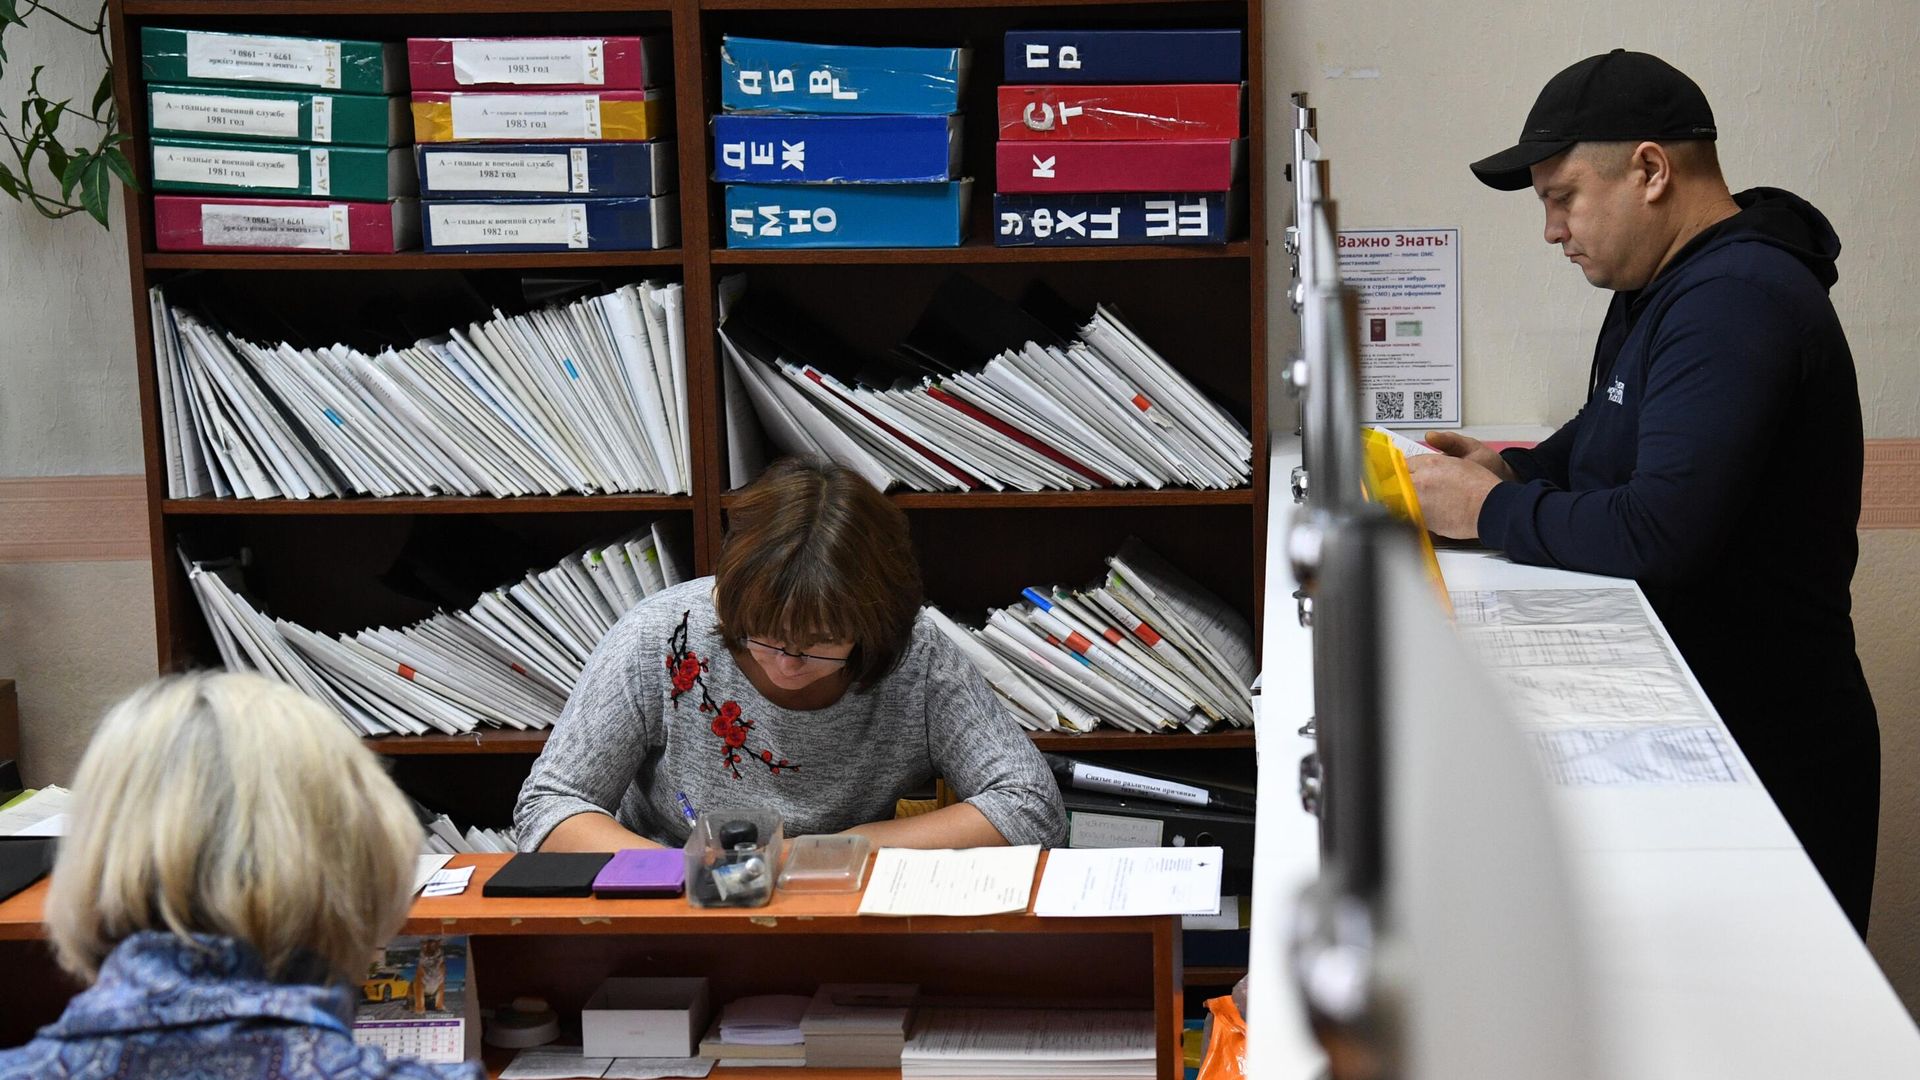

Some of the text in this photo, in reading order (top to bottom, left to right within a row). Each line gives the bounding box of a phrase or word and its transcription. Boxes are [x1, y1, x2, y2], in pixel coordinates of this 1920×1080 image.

[238, 50, 256, 58] 1980
[274, 52, 292, 61] 1979
[1026, 44, 1081, 69] П Р
[508, 65, 549, 75] 1983 год
[739, 69, 858, 100] А Б В Г
[206, 116, 244, 127] 1981 год
[1023, 102, 1083, 131] С Т
[506, 119, 547, 130] 1983 год
[723, 139, 805, 172] Д Е Ж
[1033, 154, 1055, 178] К
[207, 167, 246, 178] 1981 год
[479, 170, 517, 179] 1982 год
[731, 205, 837, 236] Л М Н О
[1000, 197, 1208, 239] У Ф Х Ц Ш Щ
[482, 228, 519, 237] 1982 год
[1338, 234, 1449, 248] Важно Знать!
